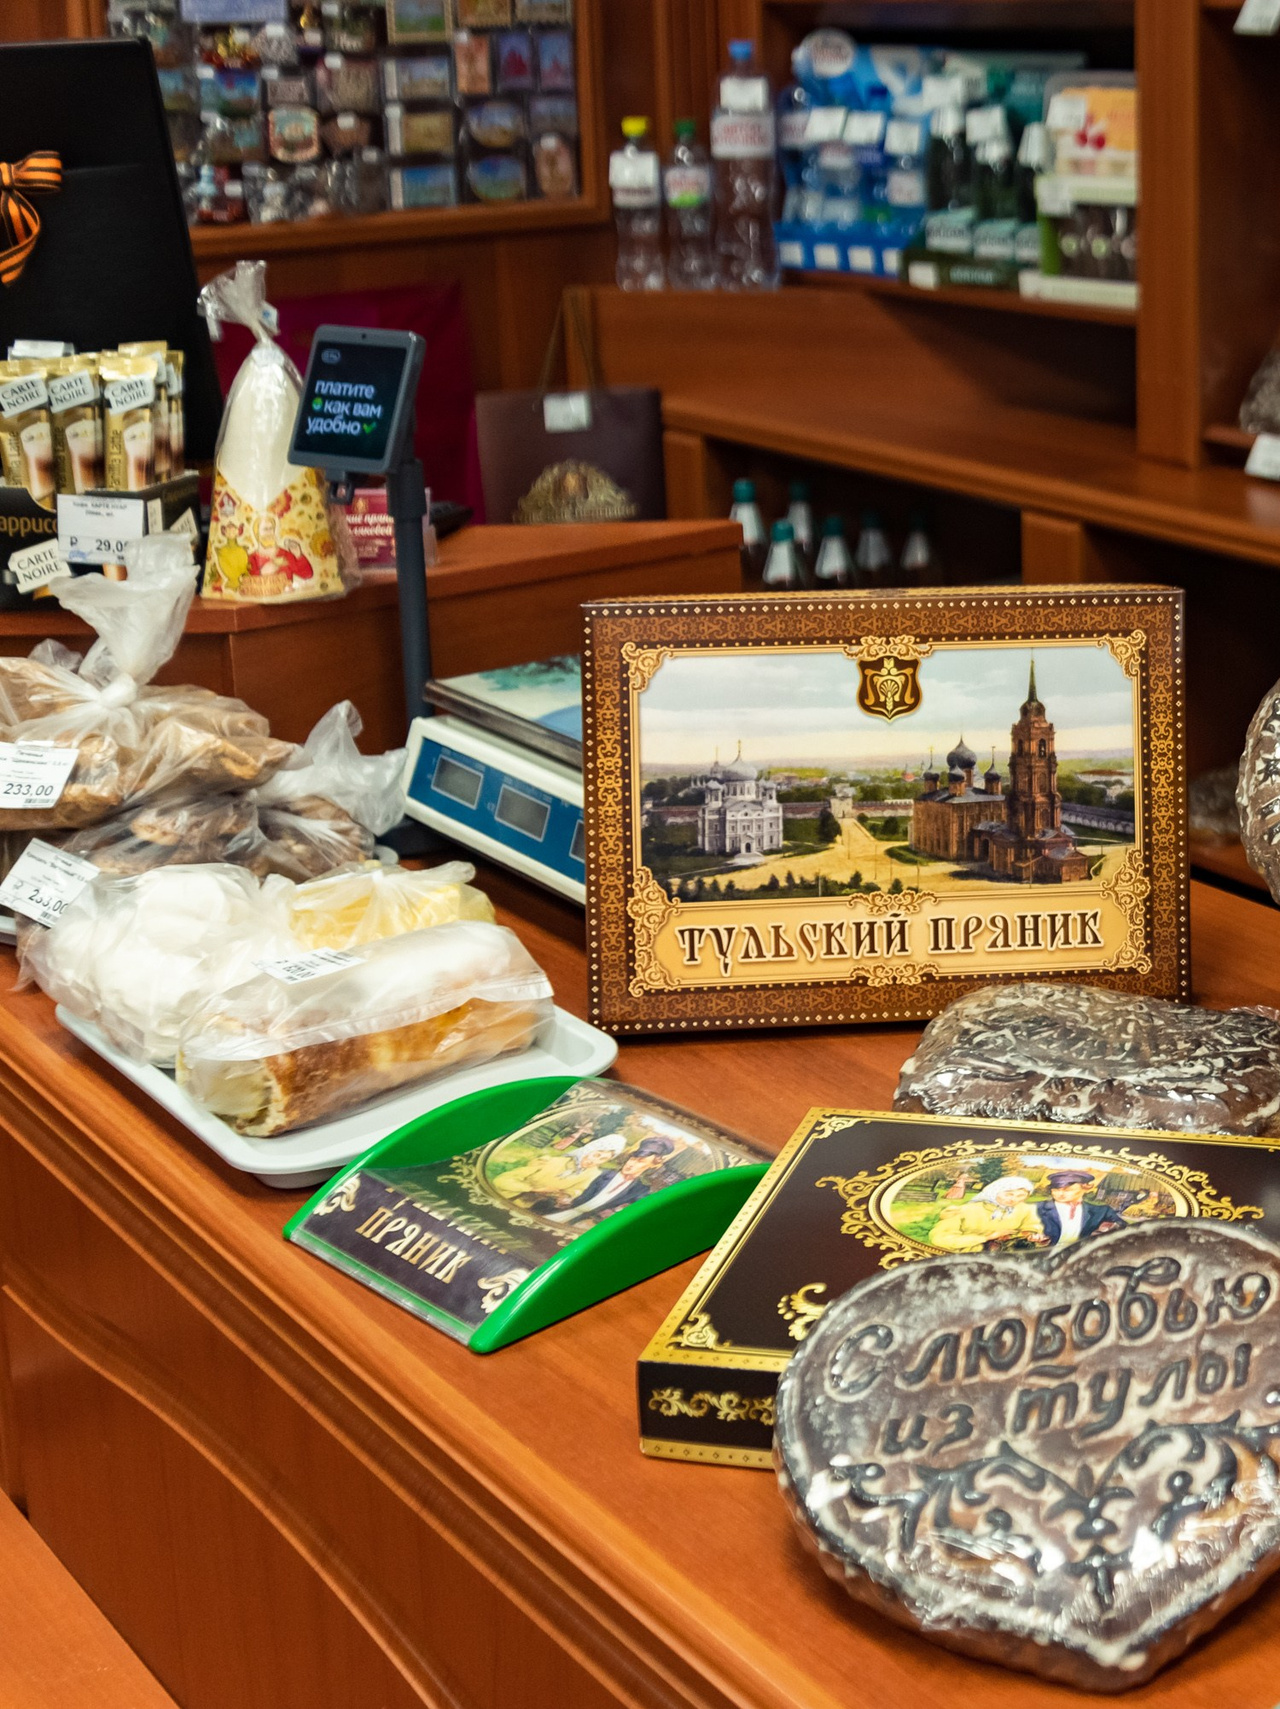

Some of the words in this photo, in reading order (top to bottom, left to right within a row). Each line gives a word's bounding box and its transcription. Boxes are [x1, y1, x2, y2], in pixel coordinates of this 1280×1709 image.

[1, 380, 39, 401] CARTE
[51, 377, 85, 396] CARTE
[55, 386, 88, 406] NOIRE
[111, 378, 146, 397] CARTE
[315, 380, 375, 399] платите
[7, 390, 42, 409] NOIRE
[115, 388, 149, 408] NOIRE
[324, 400, 351, 415] как
[353, 402, 383, 418] вам
[306, 414, 361, 436] удобно
[17, 549, 56, 571] CARTE
[22, 561, 63, 583] NOIRE
[3, 783, 54, 797] 233,00
[677, 912, 911, 976] ТУЛЬСКИЙ
[930, 911, 1102, 952] ПРЯНИК
[355, 1206, 473, 1284] ПРЯНИК
